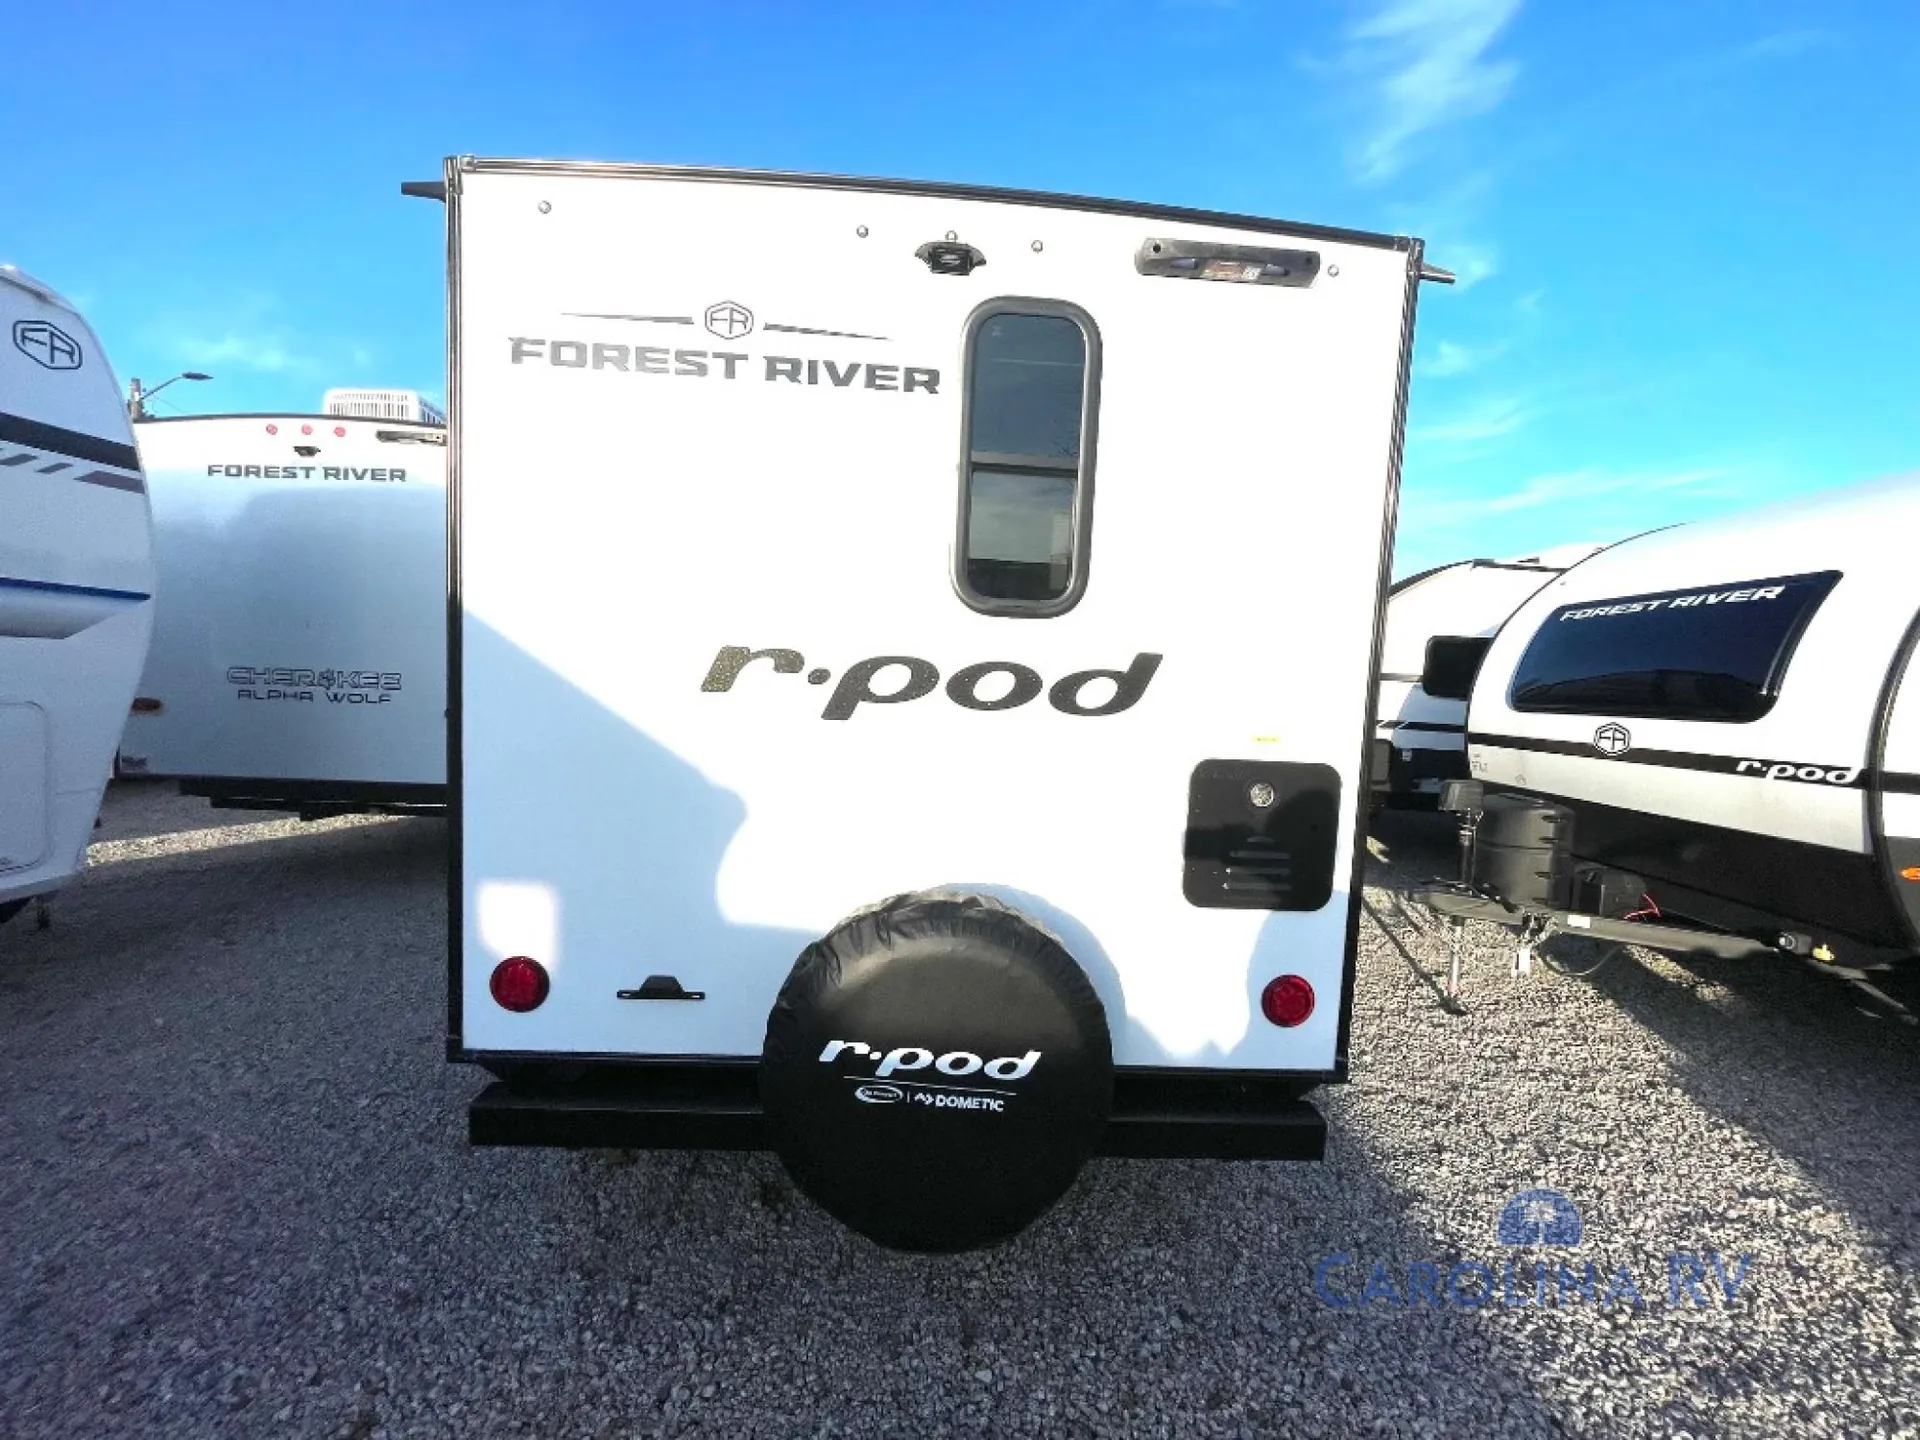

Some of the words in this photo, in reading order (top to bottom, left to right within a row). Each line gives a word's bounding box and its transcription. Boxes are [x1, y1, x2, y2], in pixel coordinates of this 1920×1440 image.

[508, 336, 749, 379] FOREST
[763, 355, 941, 394] RIVER
[207, 464, 316, 479] FOREST
[322, 466, 407, 482] RIVER
[1559, 599, 1669, 622] FOREST
[1668, 584, 1785, 609] RIVER
[238, 690, 314, 702] ALPHA
[326, 691, 392, 704] WOLF
[935, 1094, 1004, 1112] DOMETIC
